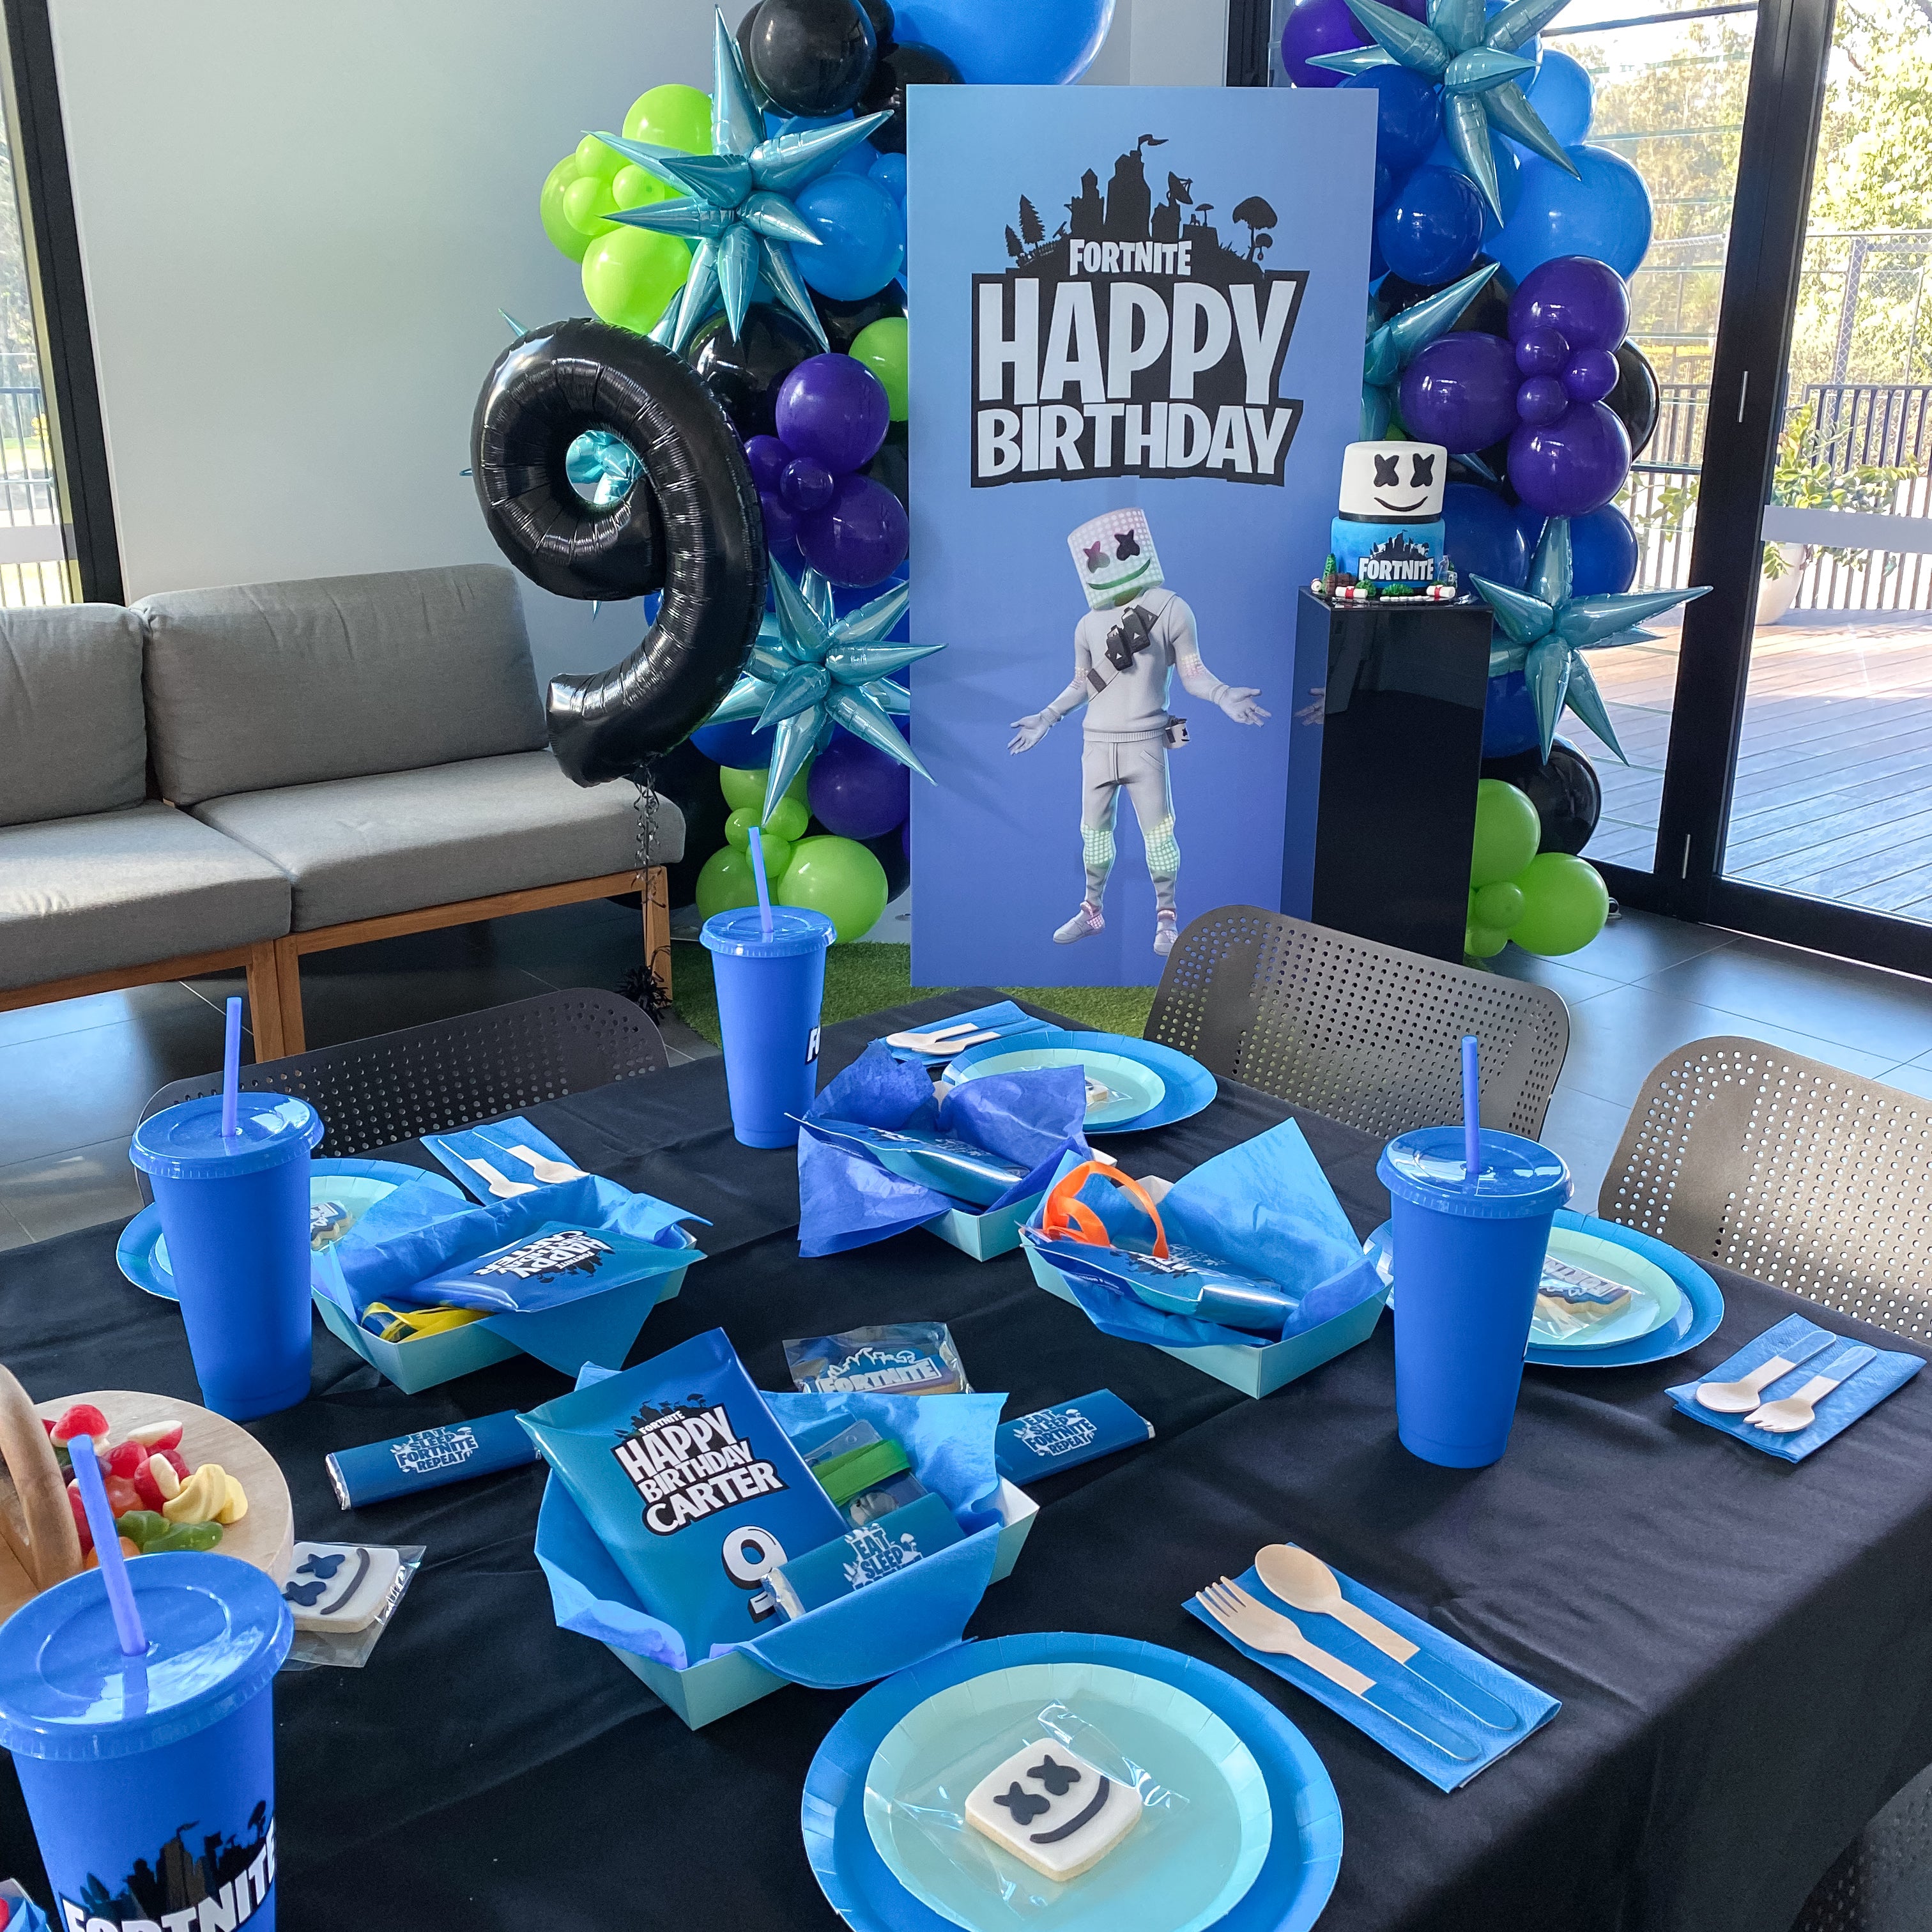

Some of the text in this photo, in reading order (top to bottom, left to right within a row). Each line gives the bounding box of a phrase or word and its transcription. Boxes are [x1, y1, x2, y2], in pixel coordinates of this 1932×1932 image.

[1069, 239, 1192, 276] FORTNITE
[979, 278, 1296, 404] HAPPY
[977, 401, 1292, 477] BIRTHDAY
[470, 318, 767, 788] 9
[1359, 557, 1434, 581] FORTNITE
[510, 1238, 613, 1278] HAPPY
[820, 1361, 936, 1393] FORTNITE
[412, 1427, 446, 1441] EAT
[638, 1410, 686, 1435] FORTNITE
[1024, 1411, 1057, 1426] EAT
[1024, 1418, 1094, 1450] FORTNITE
[1029, 1415, 1069, 1435] SLEEP
[397, 1438, 477, 1466] FORTNITE
[409, 1434, 456, 1451] SLEEP
[615, 1406, 737, 1482] HAPPY
[1048, 1433, 1090, 1453] REPEAT
[417, 1451, 465, 1471] REPEAT
[638, 1440, 753, 1503] BIRTHDAY
[647, 1462, 783, 1533] CARTER
[853, 1530, 890, 1560] EAT
[722, 1525, 789, 1623] 9
[861, 1546, 904, 1579] SLEEP
